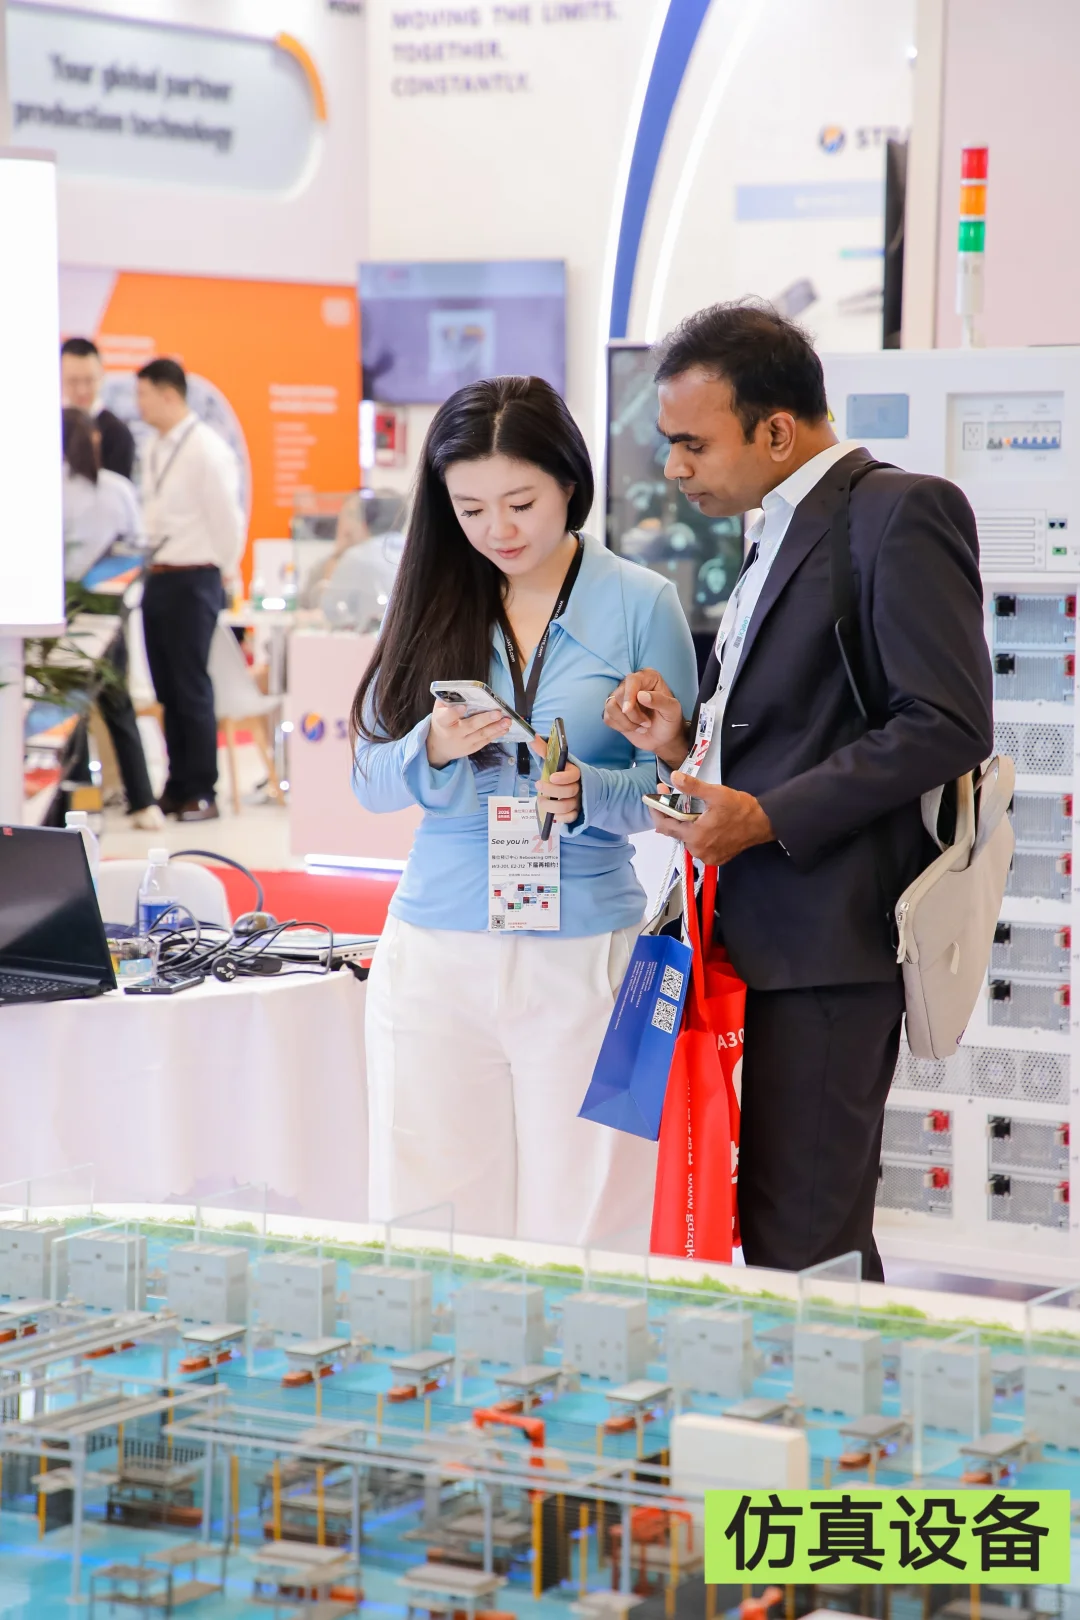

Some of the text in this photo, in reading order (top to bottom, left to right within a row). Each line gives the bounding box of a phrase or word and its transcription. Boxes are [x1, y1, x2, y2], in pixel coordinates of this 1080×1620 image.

[492, 4, 532, 24] THE
[103, 60, 159, 97] global
[165, 76, 232, 102] partner
[15, 100, 232, 153] production technology
[685, 1173, 695, 1259] www.gdzqk
